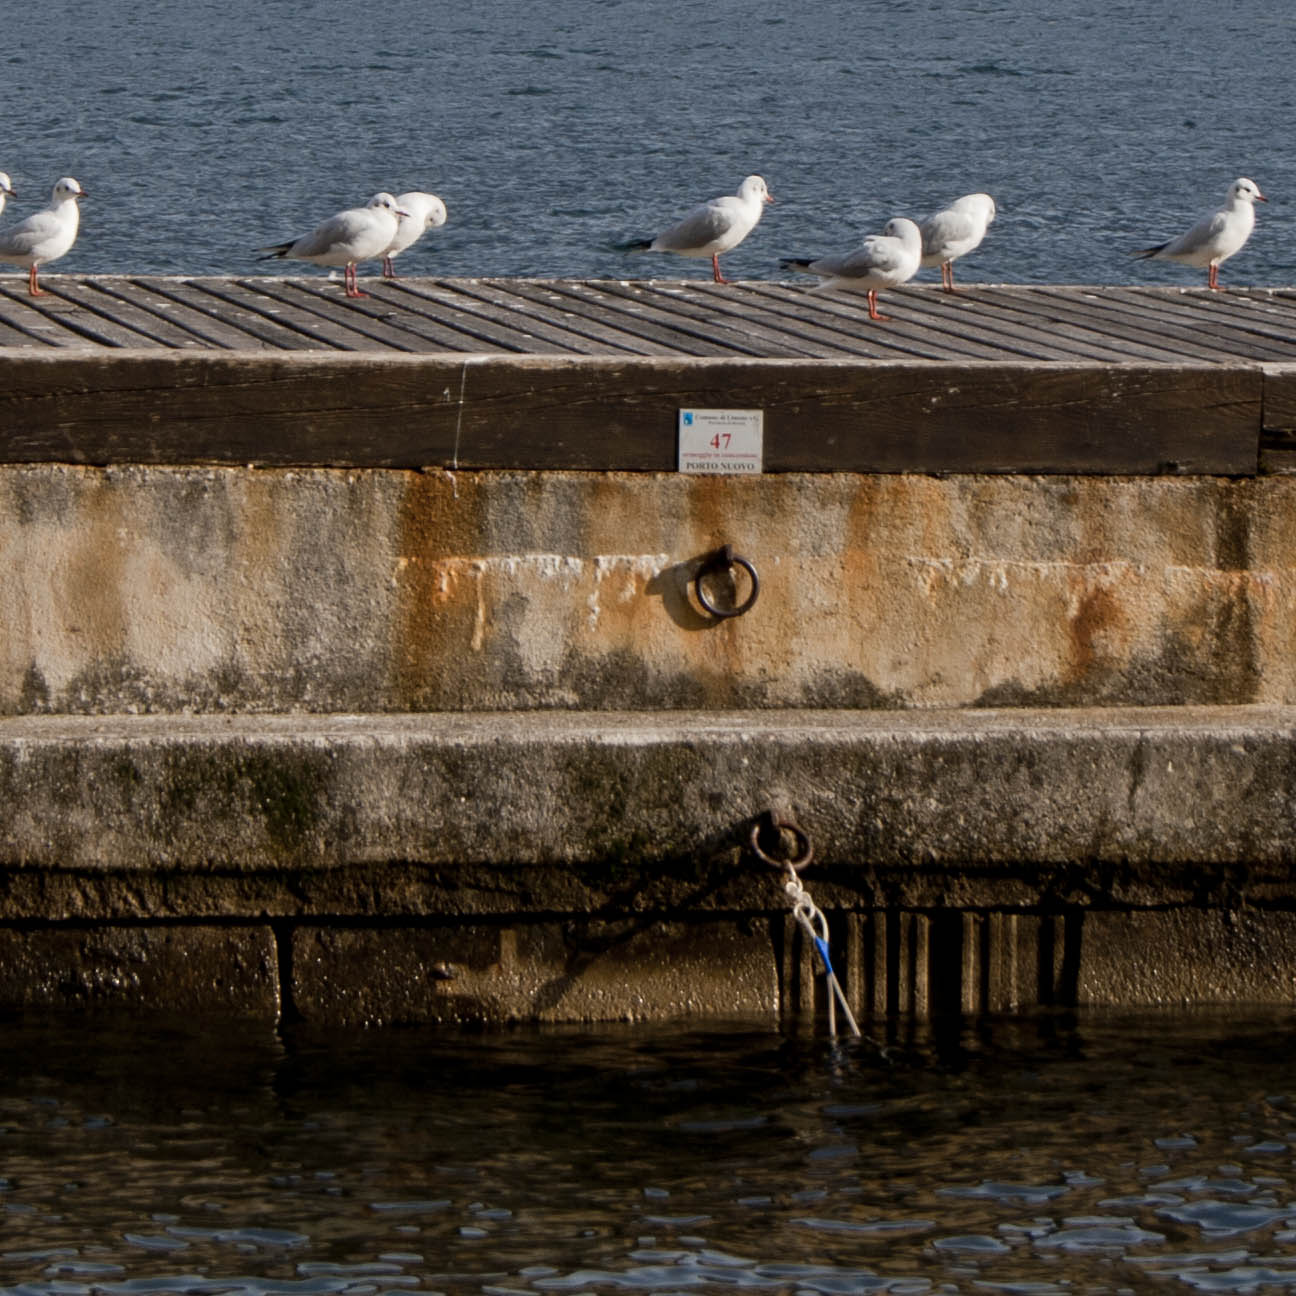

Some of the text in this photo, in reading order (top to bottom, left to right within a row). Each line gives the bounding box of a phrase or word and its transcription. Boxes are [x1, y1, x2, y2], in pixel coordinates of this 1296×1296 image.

[710, 433, 732, 449] 47
[686, 462, 755, 470] PORTO NUOVO
